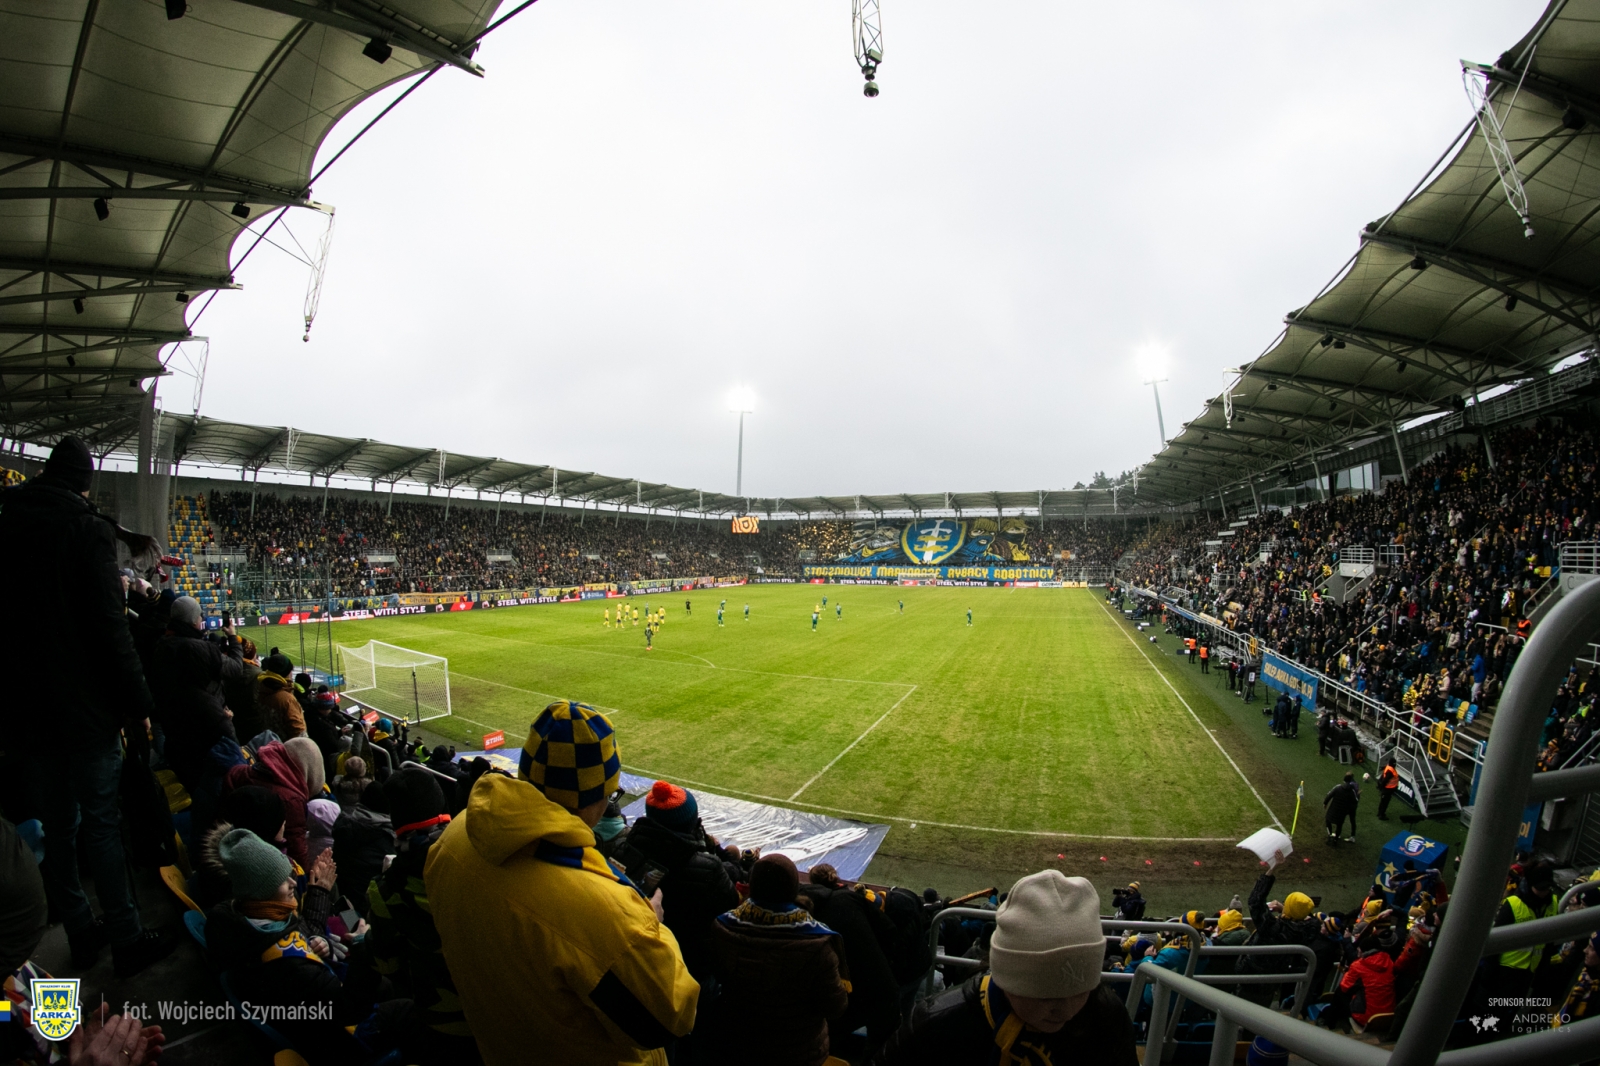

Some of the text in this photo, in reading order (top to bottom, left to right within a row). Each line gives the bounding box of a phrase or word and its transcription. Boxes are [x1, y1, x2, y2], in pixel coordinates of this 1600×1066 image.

[497, 599, 518, 607] STEEL
[520, 597, 537, 605] WITH
[342, 605, 426, 618] STEEL WITH STYLE
